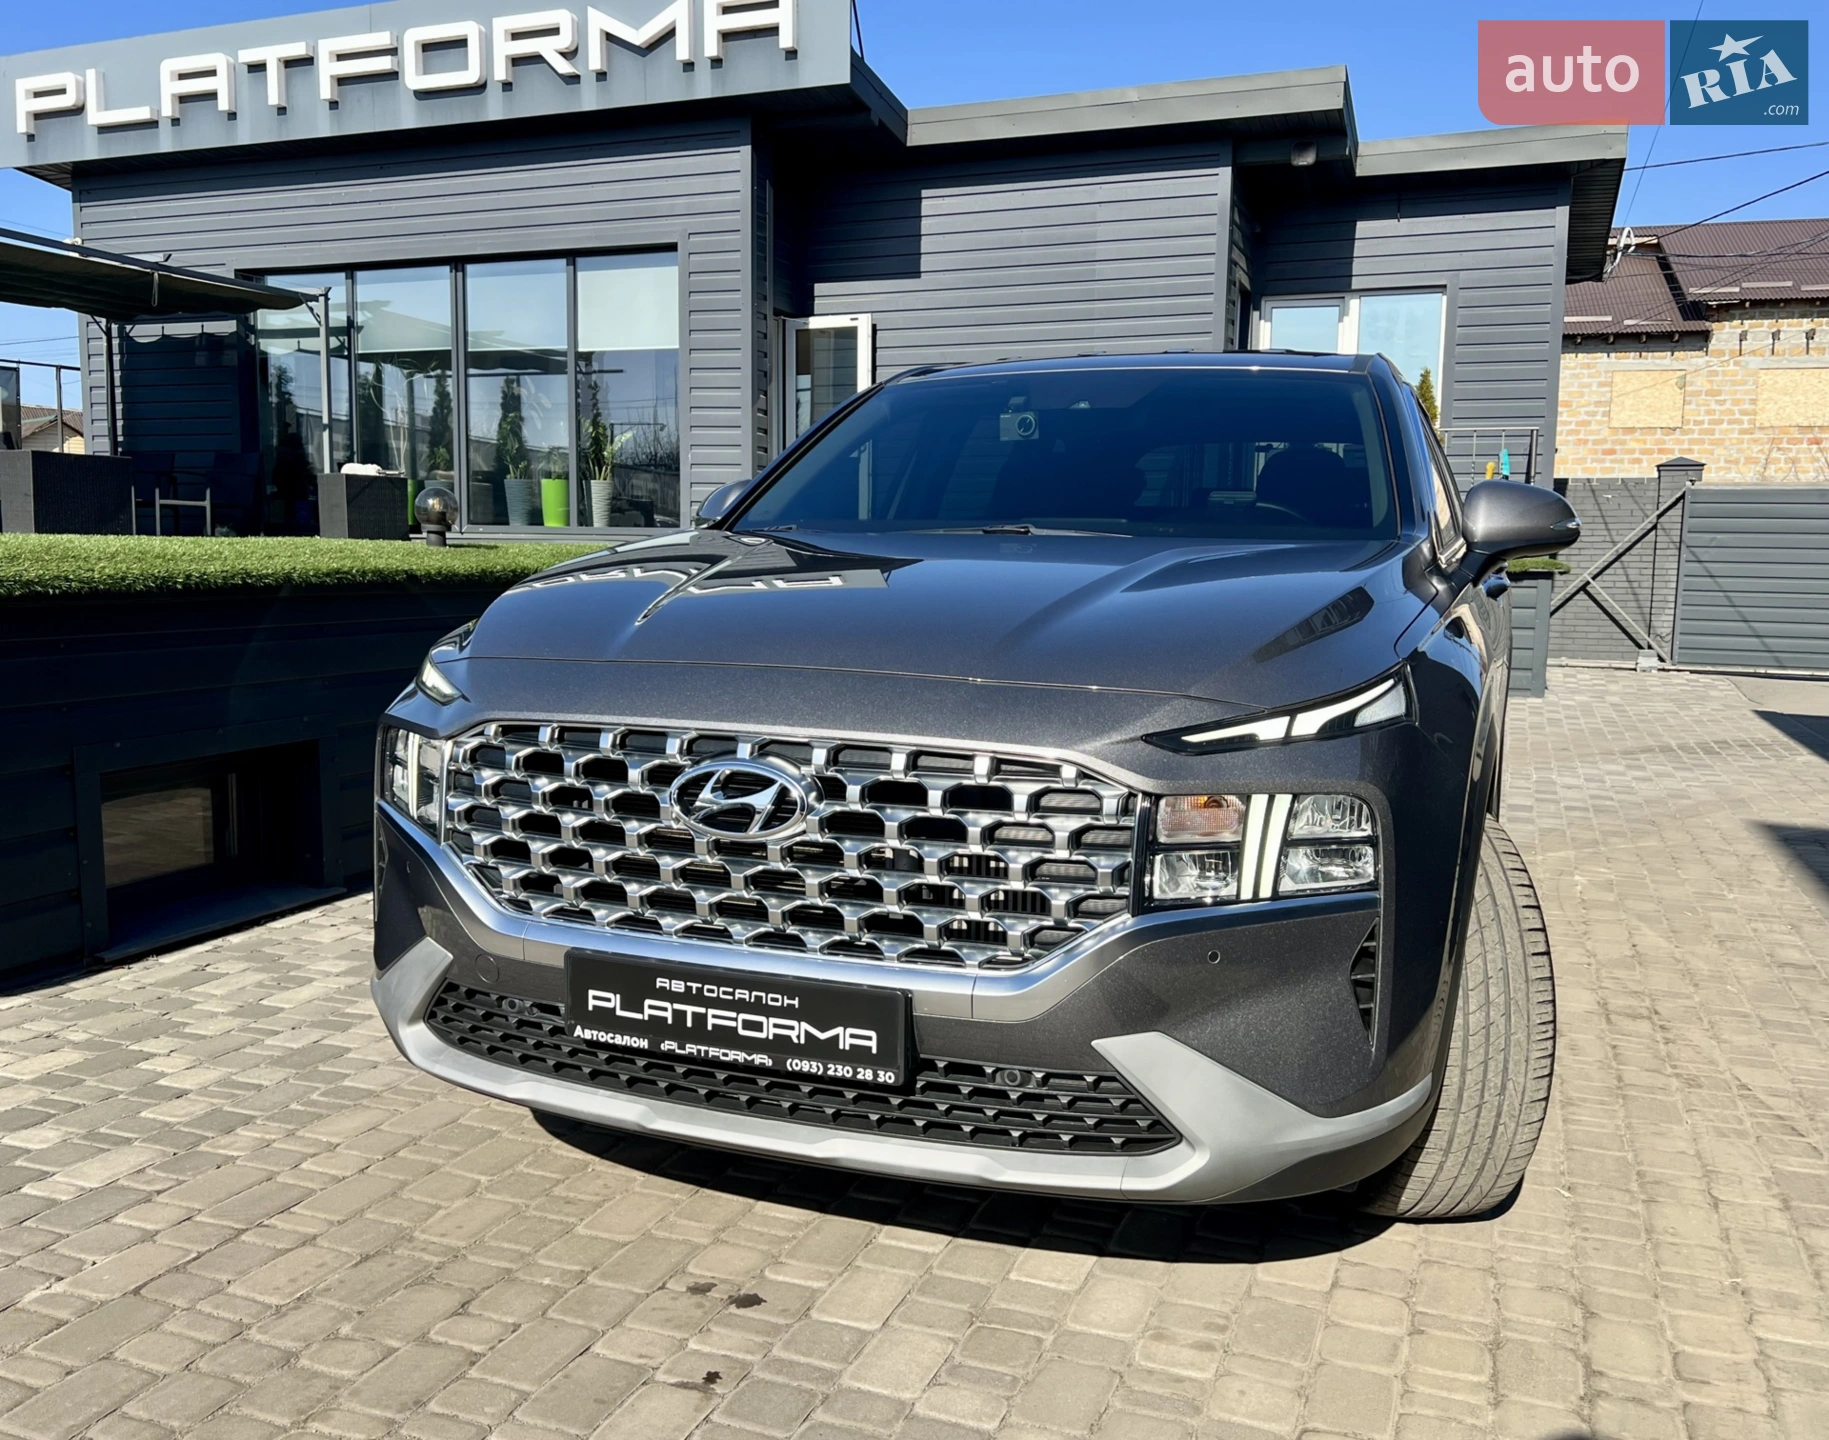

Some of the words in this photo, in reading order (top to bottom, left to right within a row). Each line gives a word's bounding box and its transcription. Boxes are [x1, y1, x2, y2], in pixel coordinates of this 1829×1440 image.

[15, 0, 798, 136] PLATFORMA
[587, 989, 878, 1054] PLATFORMA
[655, 977, 799, 1008] АВТОСАЛОН
[573, 1024, 649, 1050] Автосалон
[786, 1058, 824, 1075] (093)
[826, 1063, 853, 1078] 230
[856, 1067, 874, 1081] 28
[876, 1070, 895, 1084] 30
